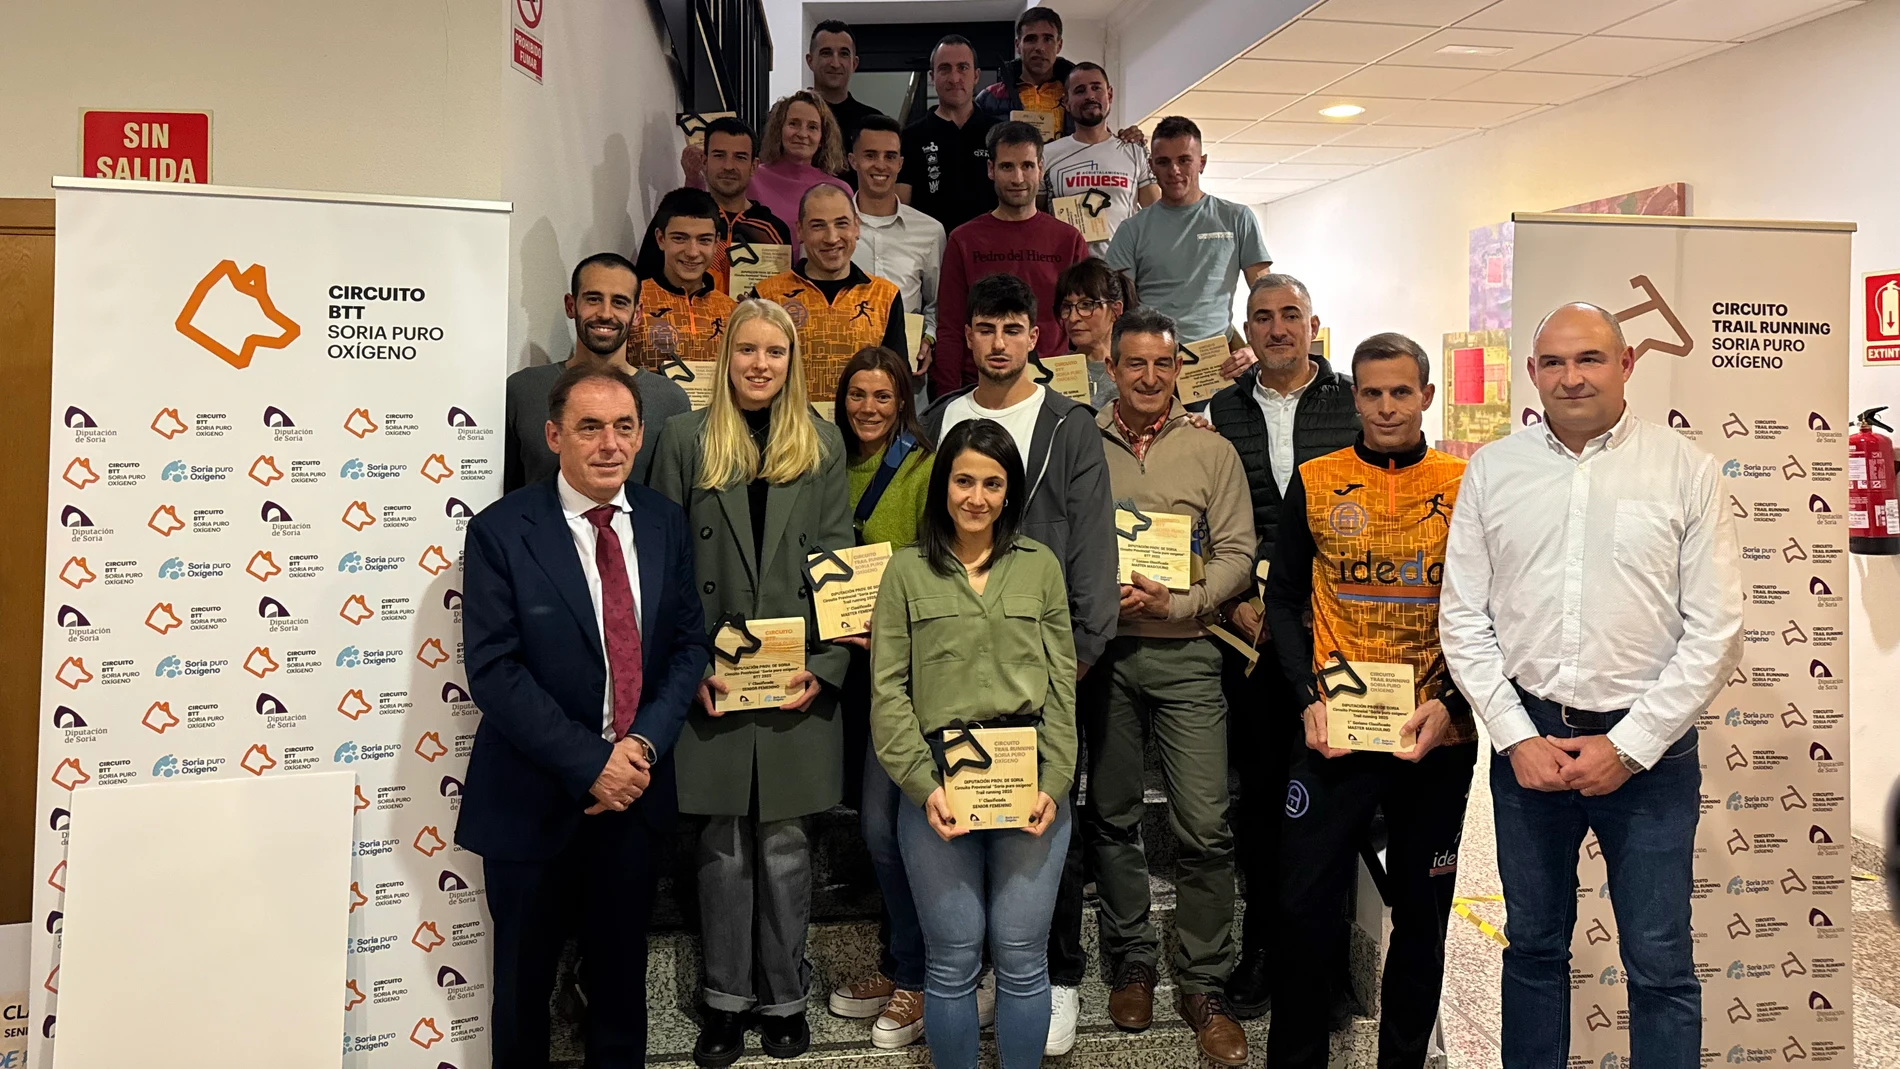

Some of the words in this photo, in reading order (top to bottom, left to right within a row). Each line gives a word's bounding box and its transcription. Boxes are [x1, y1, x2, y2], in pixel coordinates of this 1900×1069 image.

[515, 33, 541, 59] PROHIBIDO
[520, 50, 537, 70] FUMAR
[124, 122, 168, 148] SIN
[97, 156, 196, 183] SALIDA
[972, 250, 1005, 263] Pedro
[1007, 249, 1023, 261] del
[1026, 249, 1062, 262] Hierro
[329, 285, 425, 301] CIRCUITO
[329, 305, 365, 319] BTT
[1712, 302, 1788, 316] CIRCUITO
[328, 325, 387, 340] SORIA
[393, 327, 444, 341] PURO
[1712, 320, 1757, 333] TRAIL
[1760, 321, 1830, 335] RUNNING
[328, 342, 416, 360] OXÍGENO
[1712, 337, 1760, 351] SORIA
[1763, 339, 1805, 351] PURO
[1712, 353, 1782, 368] OXÍGENO
[275, 428, 313, 436] Diputación
[191, 465, 213, 473] Soria
[215, 466, 233, 474] puro
[188, 562, 210, 570] Soria
[359, 840, 379, 848] Soria
[382, 839, 399, 847] puro
[452, 921, 479, 929] CIRCUITO
[357, 937, 378, 946] Soria
[380, 935, 398, 943] puro
[448, 983, 484, 994] Diputación
